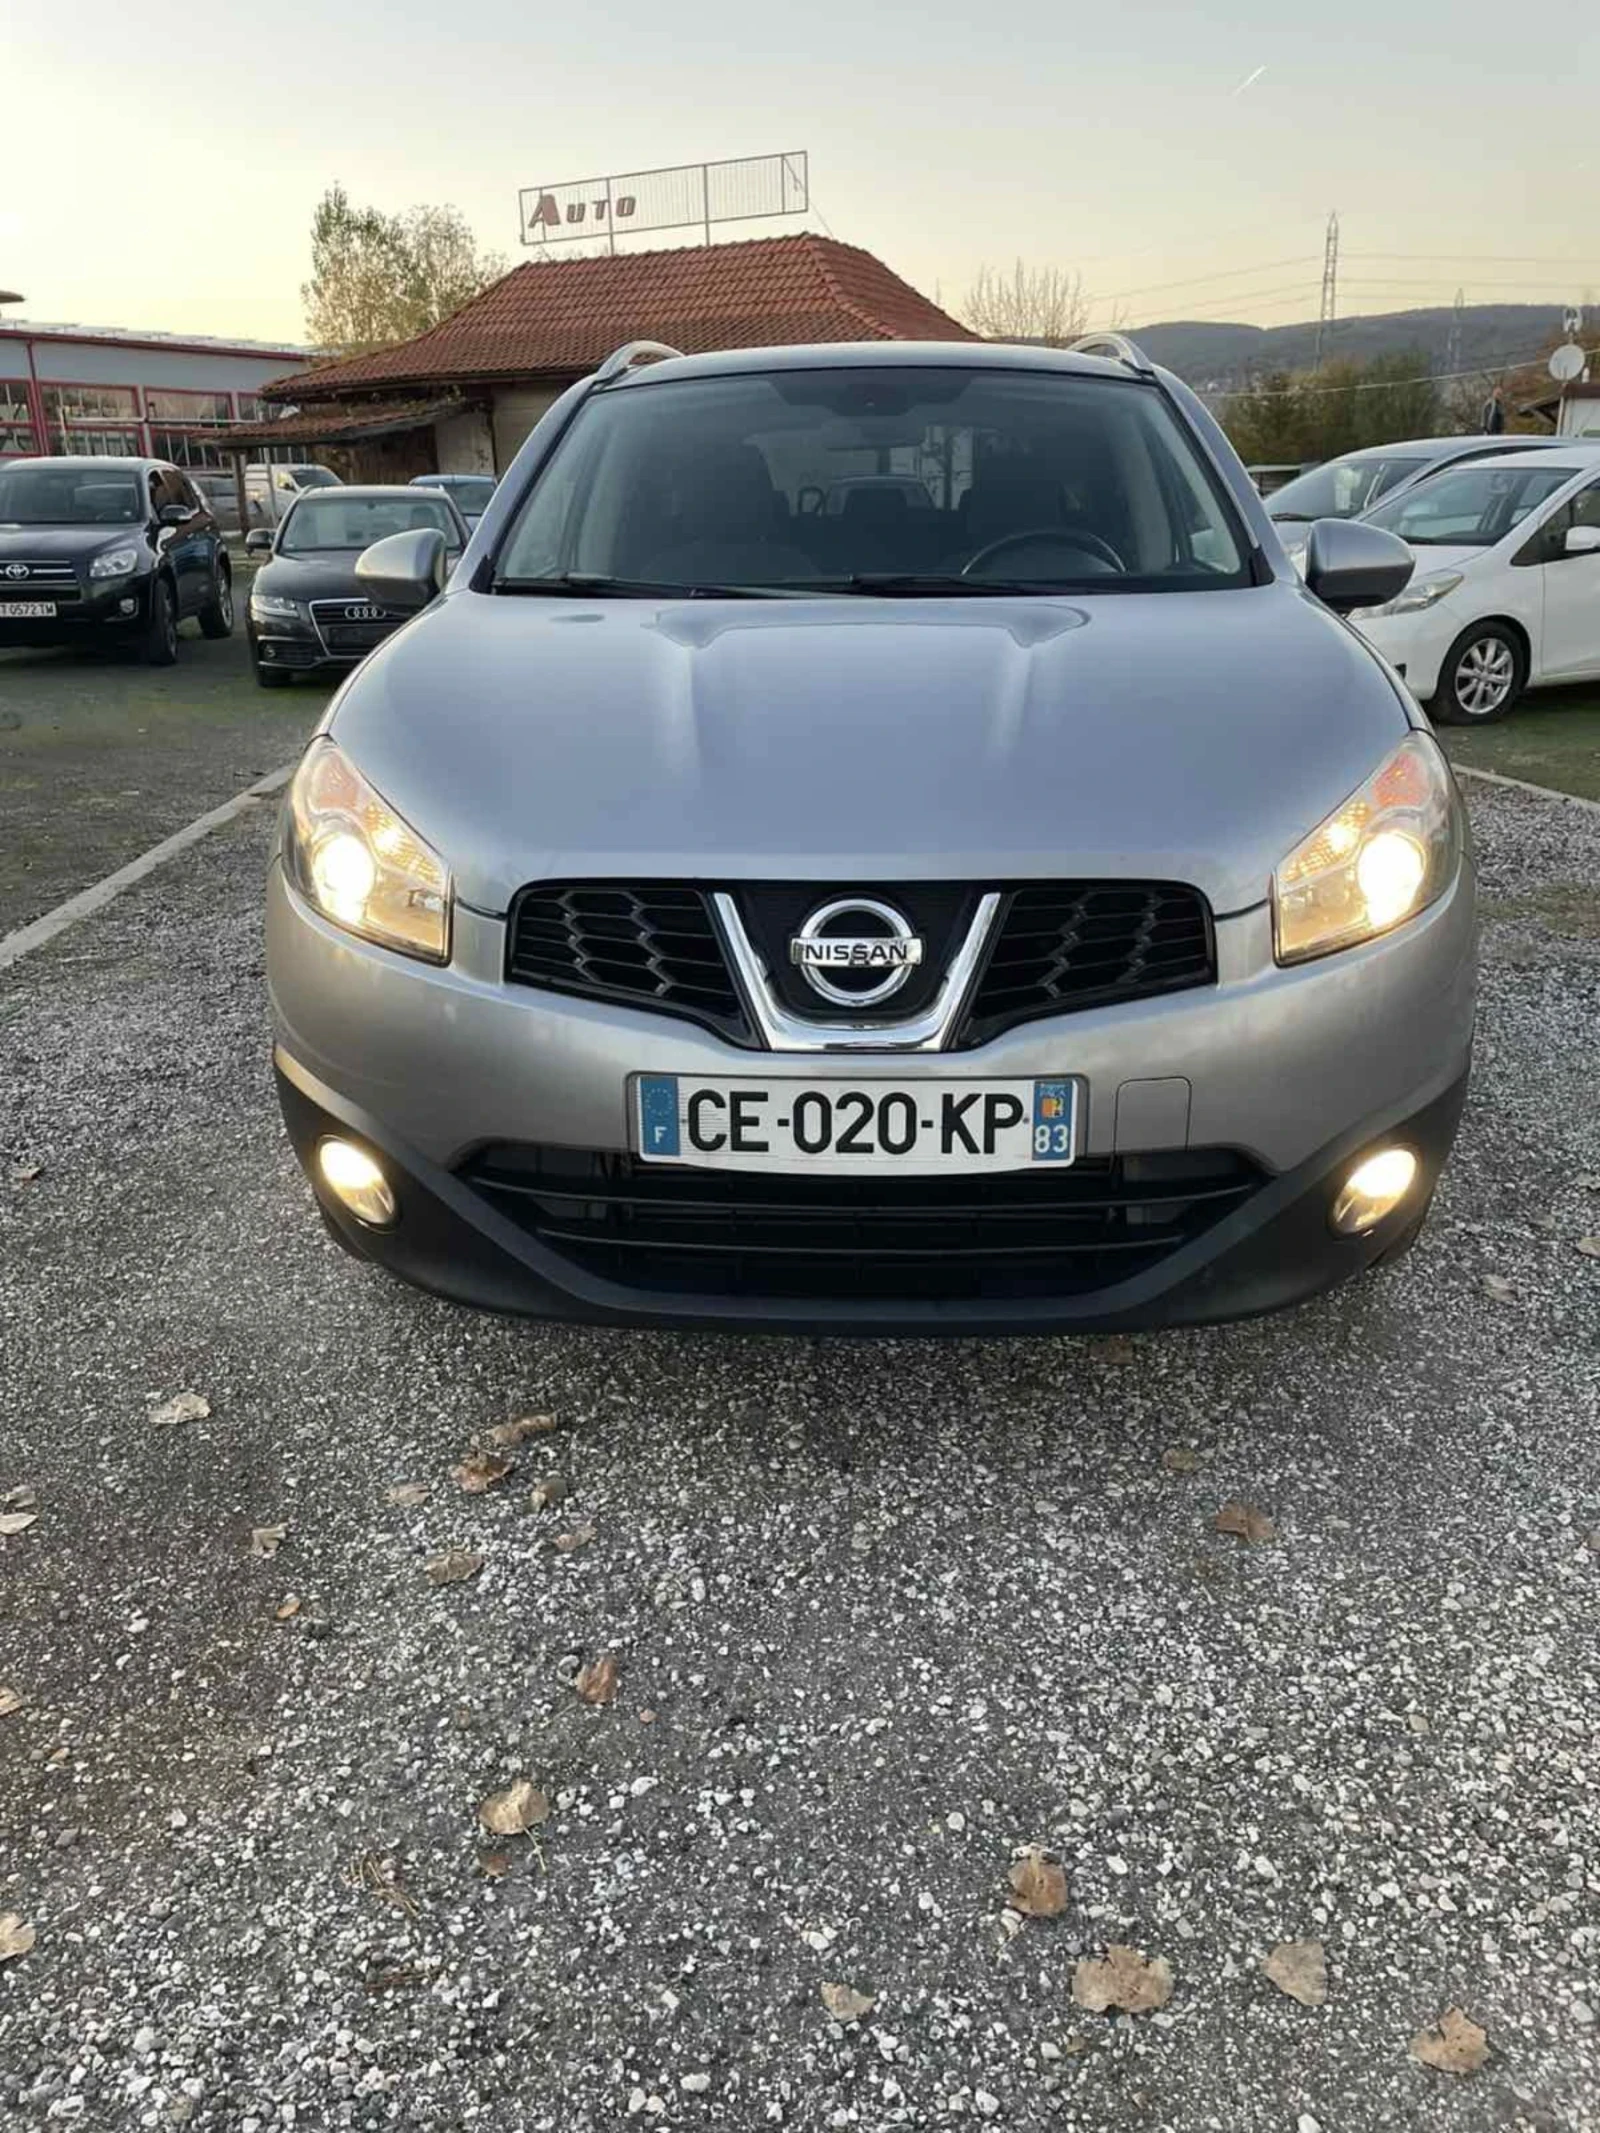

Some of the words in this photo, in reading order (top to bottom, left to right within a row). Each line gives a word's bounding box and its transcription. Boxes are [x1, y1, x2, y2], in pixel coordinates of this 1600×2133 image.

[804, 944, 908, 961] NISSAN
[688, 1088, 1025, 1156] CE-020-KP
[654, 1125, 667, 1144] F
[1034, 1124, 1069, 1154] 83
